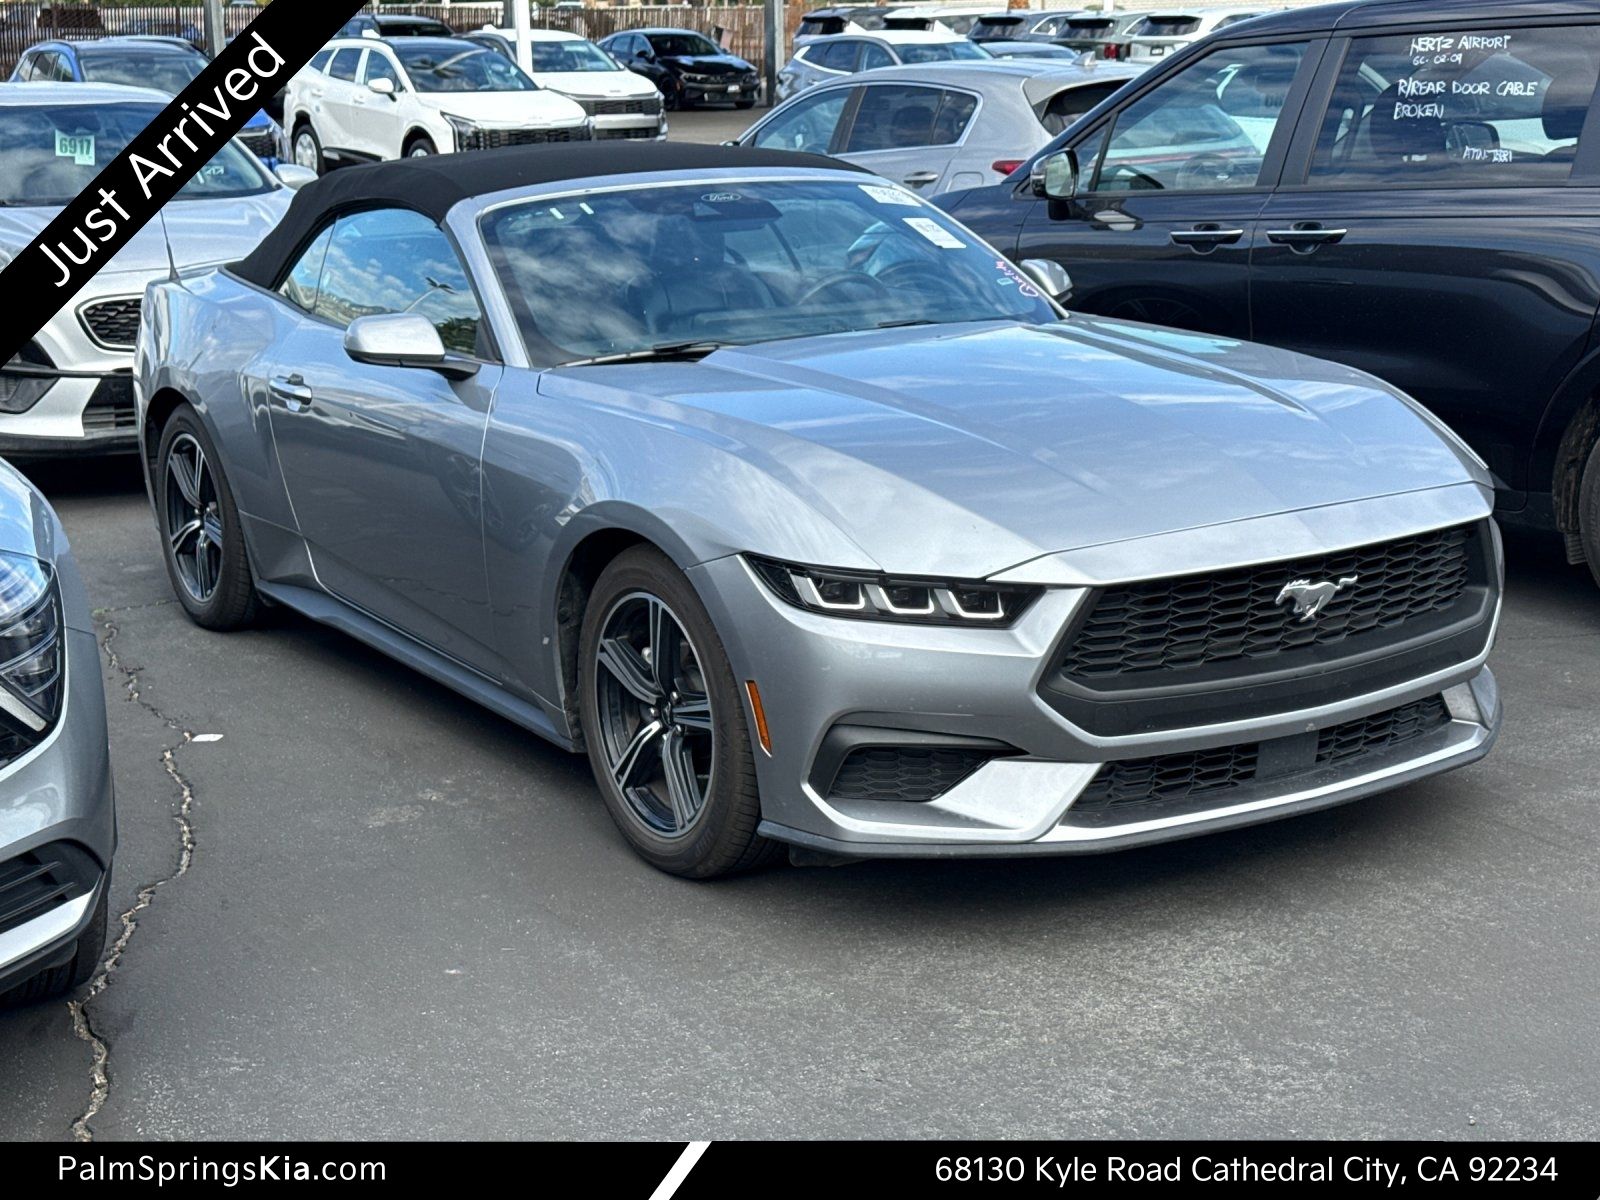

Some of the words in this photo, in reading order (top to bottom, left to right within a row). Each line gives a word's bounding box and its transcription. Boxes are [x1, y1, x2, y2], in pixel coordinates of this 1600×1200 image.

[1409, 36, 1454, 57] HERTZ
[1457, 35, 1512, 50] AIRPORT
[1397, 77, 1446, 98] R/REAR
[1452, 80, 1490, 95] DOOR
[1496, 80, 1538, 96] CABLE
[1393, 101, 1445, 120] BROKEN
[59, 137, 91, 155] 6917
